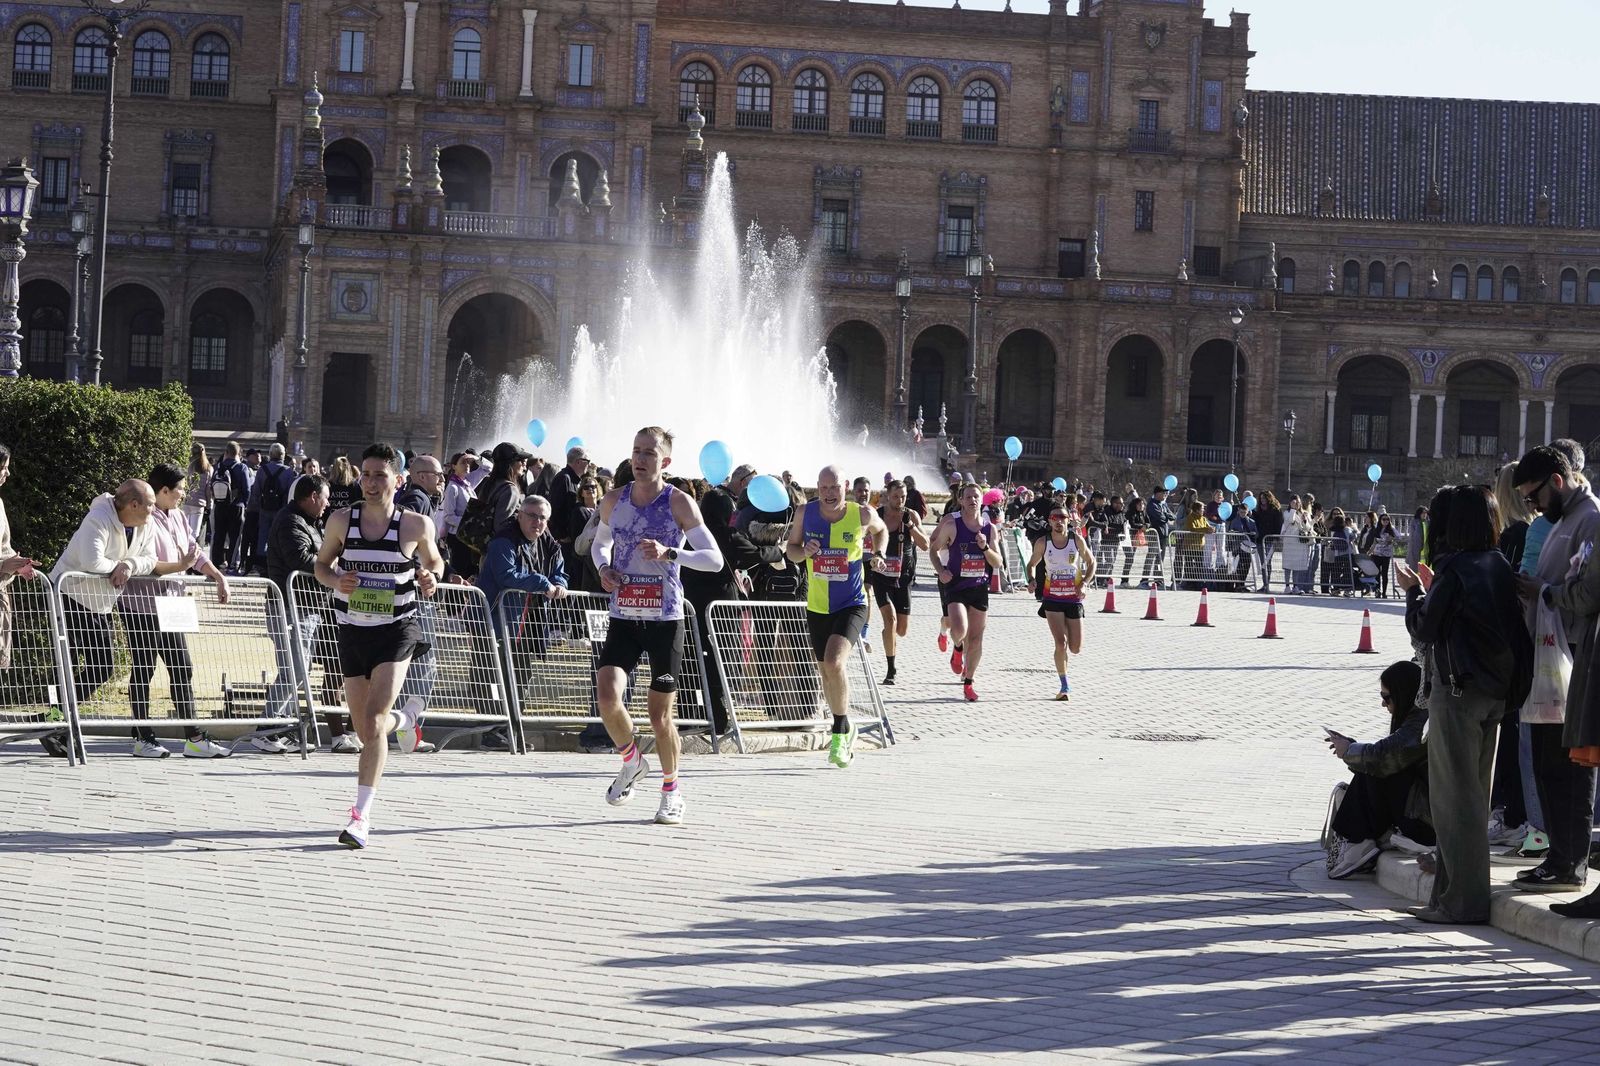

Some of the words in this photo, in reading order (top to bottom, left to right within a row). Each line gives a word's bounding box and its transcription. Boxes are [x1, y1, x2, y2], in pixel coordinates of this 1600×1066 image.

[344, 562, 400, 573] HIGHGATE
[362, 592, 377, 600] 3105
[349, 600, 392, 613] MATTHEW
[617, 597, 637, 606] PUCK
[638, 598, 662, 606] FUTIN
